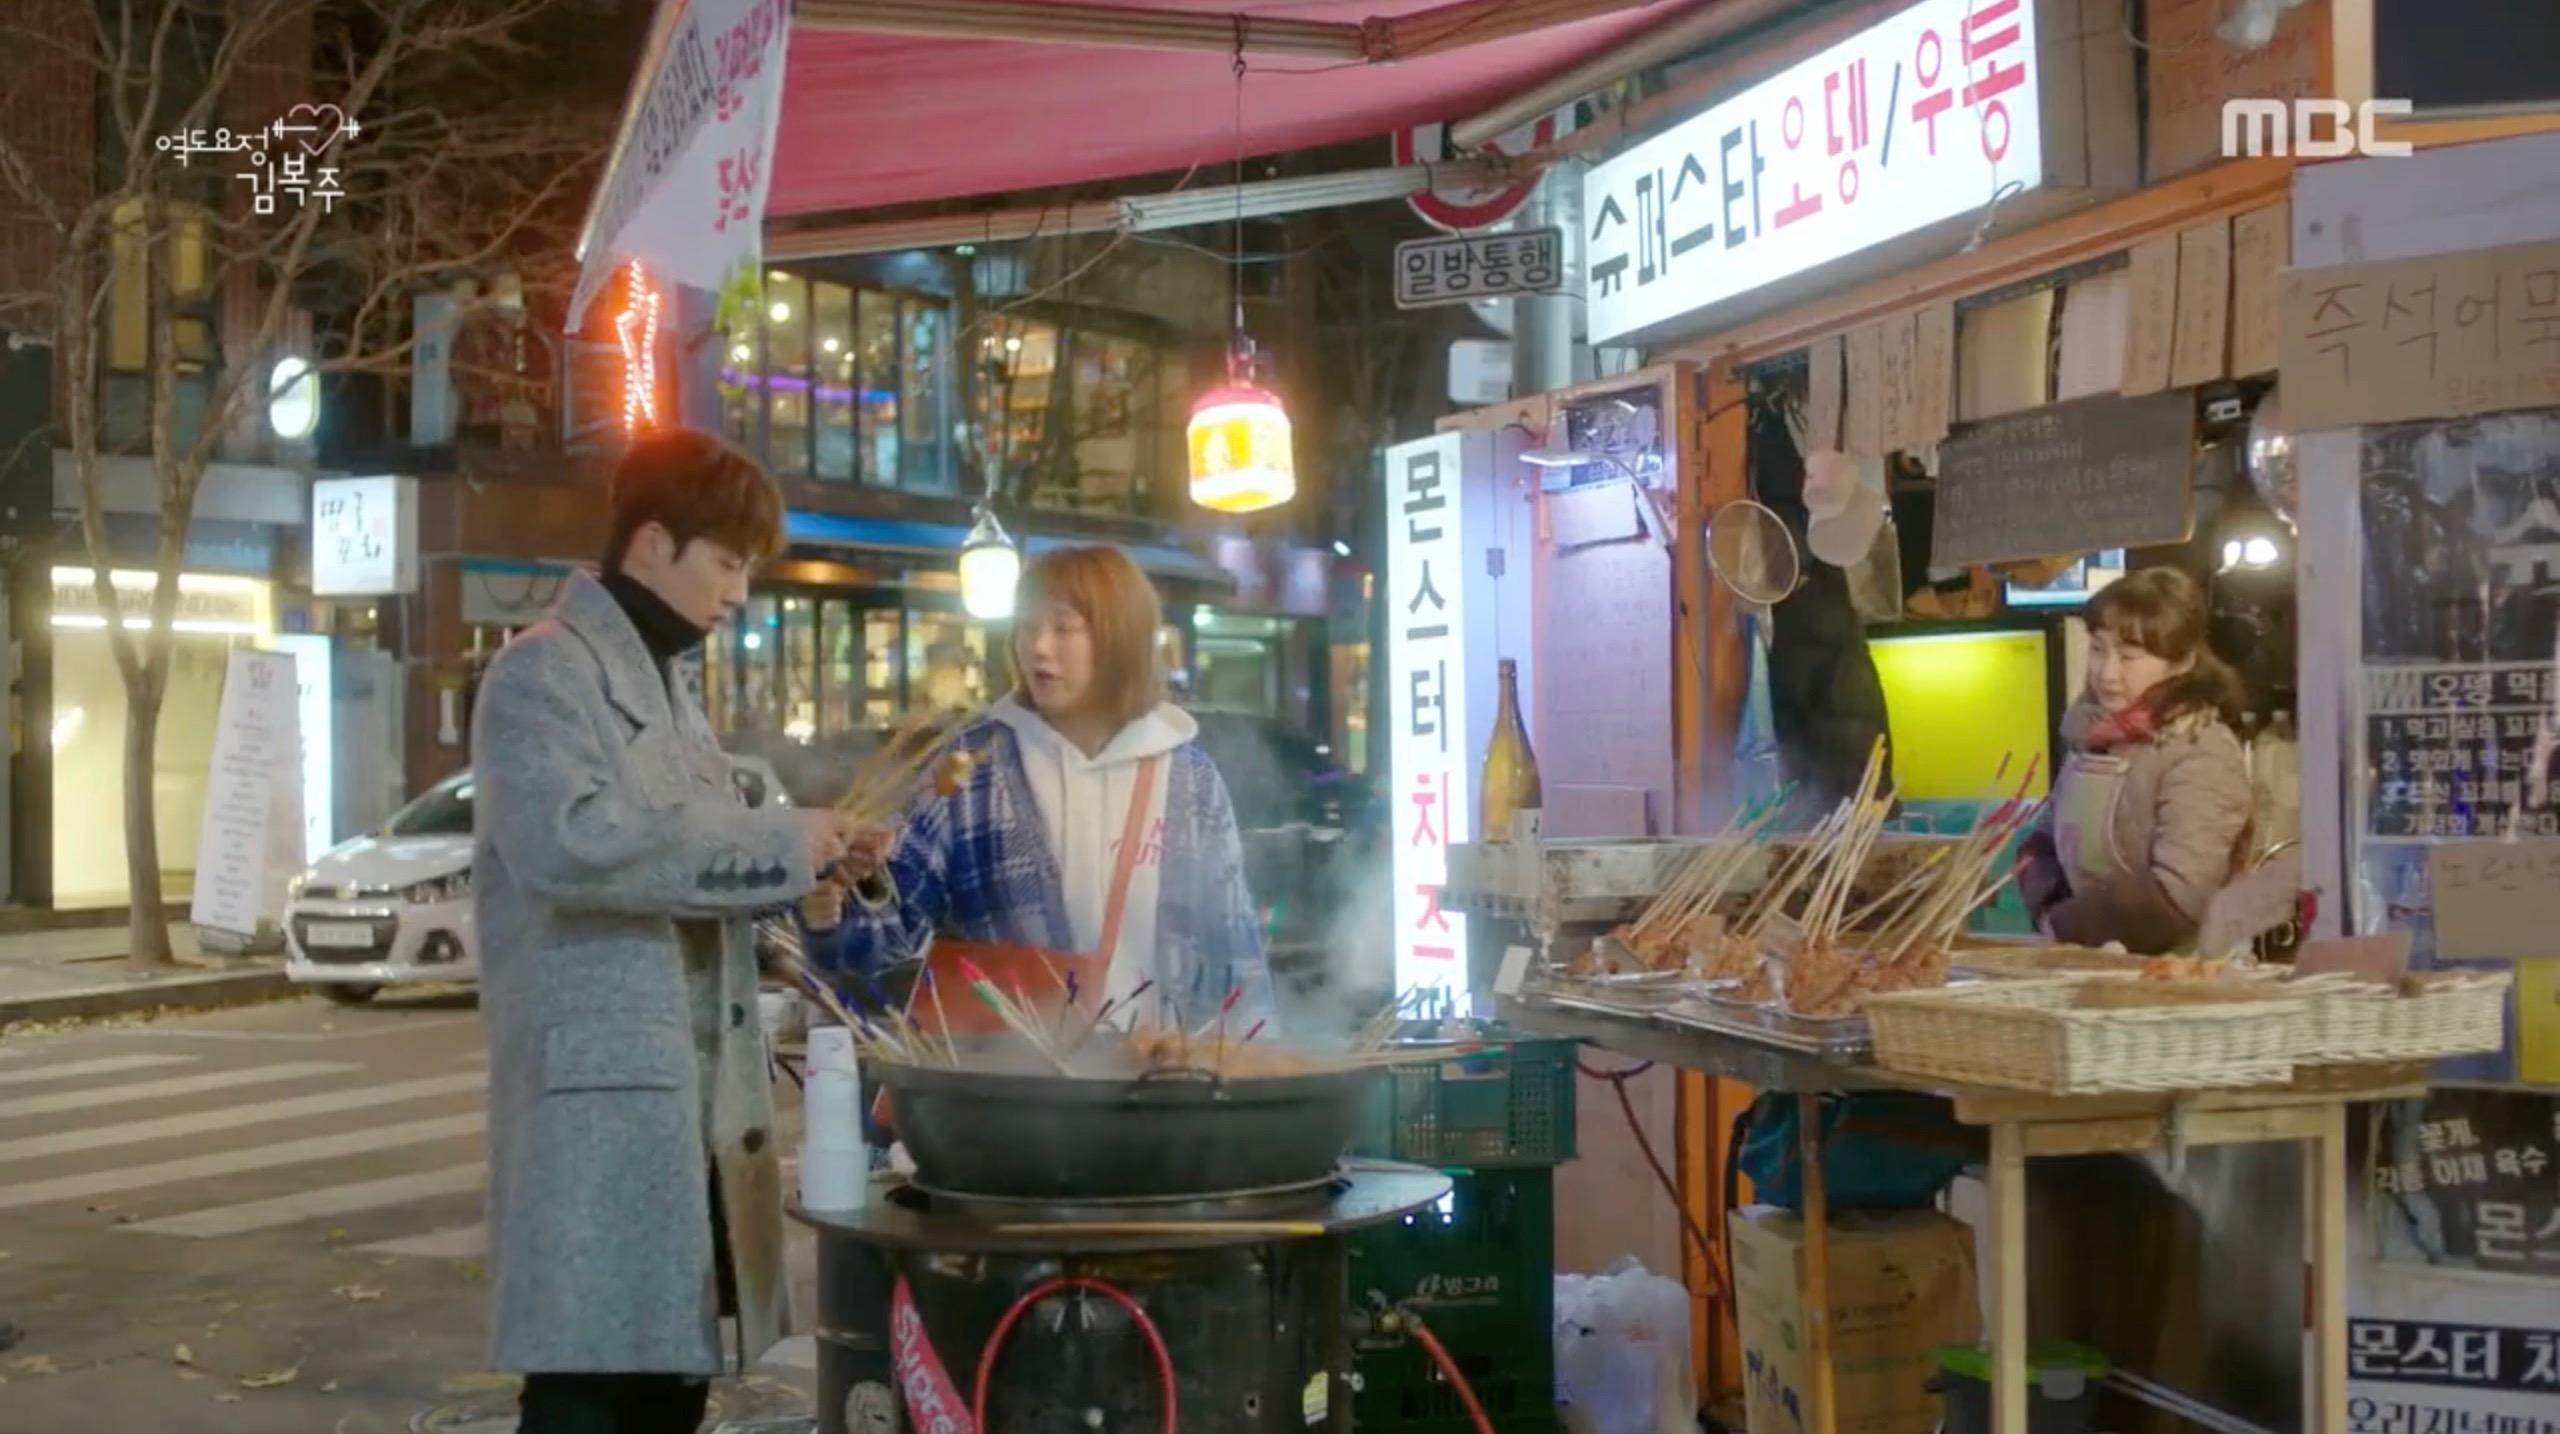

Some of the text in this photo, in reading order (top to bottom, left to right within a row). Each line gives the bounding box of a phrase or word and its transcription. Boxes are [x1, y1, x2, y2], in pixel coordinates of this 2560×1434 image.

[1407, 237, 1552, 296] 일방통행
[2429, 672, 2494, 706] 오뎅
[2494, 1145, 2550, 1178] 육수
[2351, 1323, 2499, 1381] 몬스터
